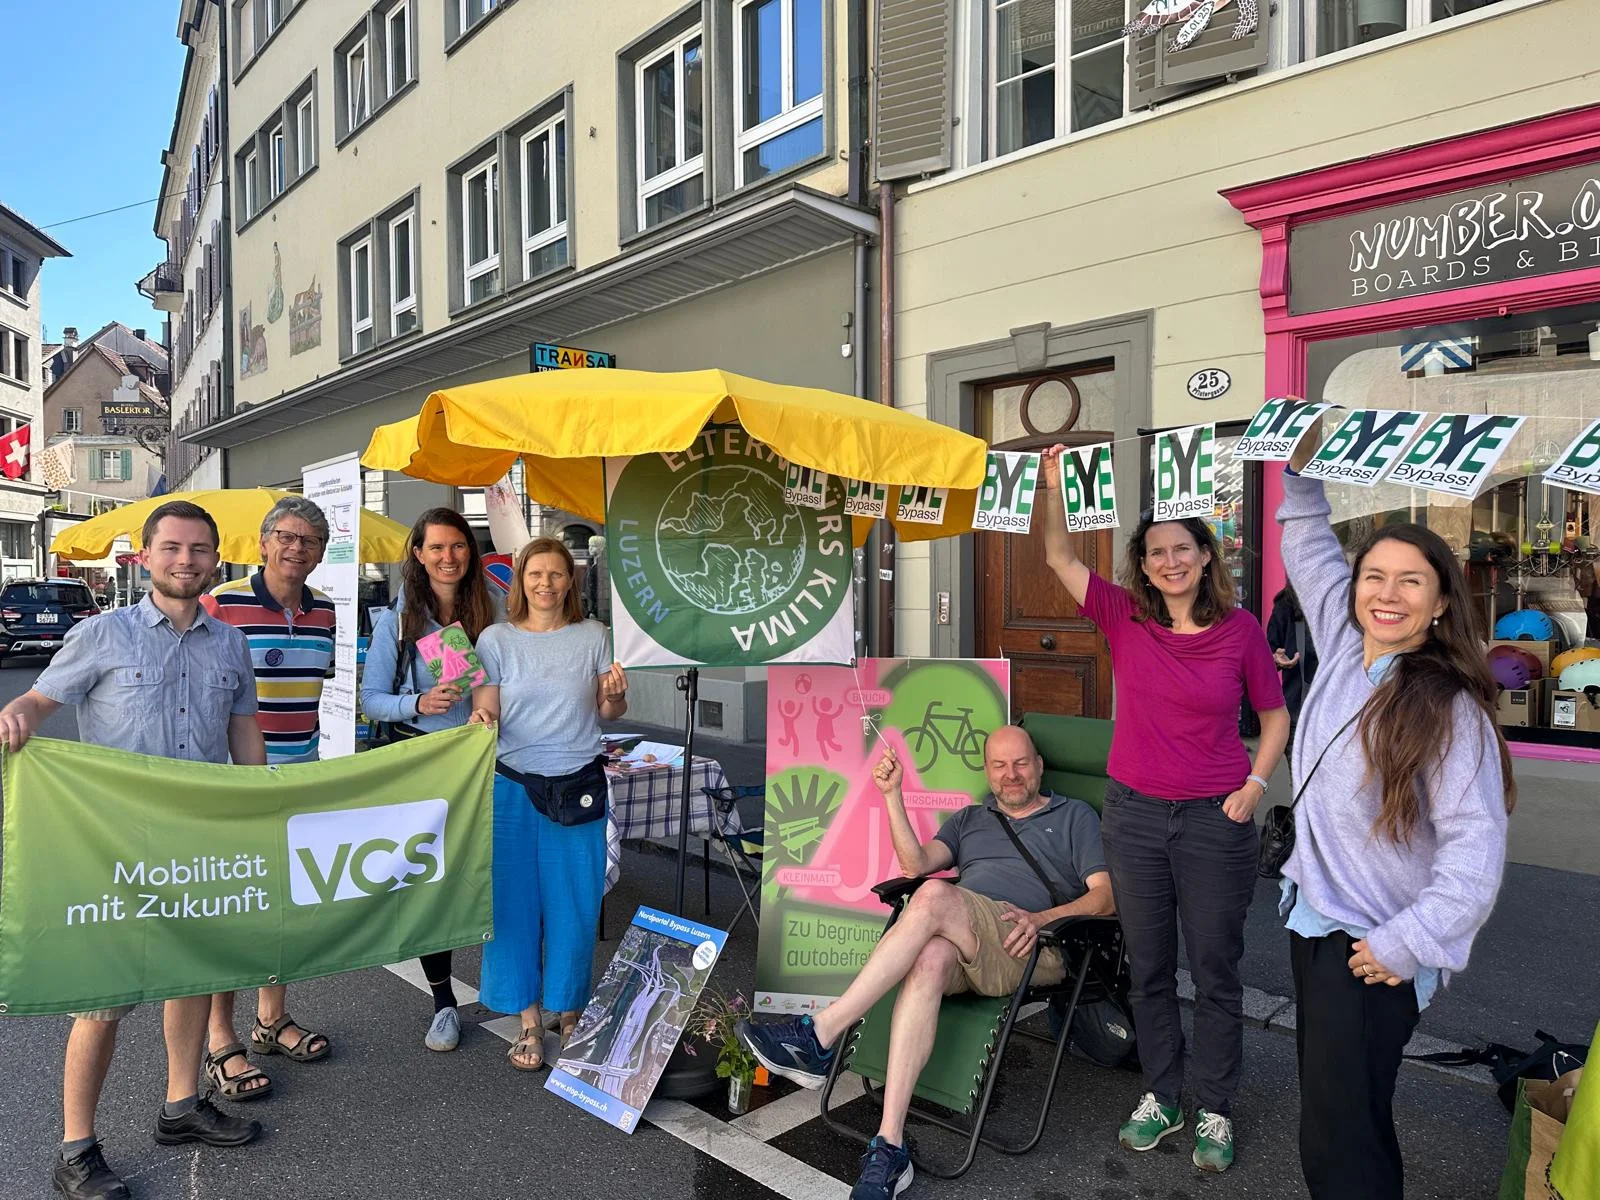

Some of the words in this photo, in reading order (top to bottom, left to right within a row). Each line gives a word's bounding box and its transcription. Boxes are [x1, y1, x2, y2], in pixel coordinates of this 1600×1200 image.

[1350, 255, 1490, 297] BOARDS
[1517, 249, 1535, 269] &
[1198, 371, 1219, 389] 25
[104, 406, 151, 414] BASLERTOR
[1241, 399, 1323, 440] BYE
[1236, 437, 1293, 454] Bypass!
[1315, 411, 1420, 469] BYE
[1398, 415, 1521, 474] BYE
[1158, 427, 1213, 501] BYE
[1306, 459, 1381, 481] Bypass!
[1393, 463, 1477, 487] Bypass!
[977, 453, 1038, 515] BYE
[1062, 447, 1113, 513] BYE
[785, 487, 822, 505] Bypass!
[845, 497, 884, 513] Bypass!
[1157, 495, 1213, 520] Bypass!
[896, 504, 940, 521] Bypass!
[976, 510, 1030, 528] Bypass!
[1068, 510, 1117, 529] Bypass!
[618, 519, 669, 624] LUZERN
[730, 568, 838, 652] KLIMA
[852, 691, 885, 703] BRUCH
[113, 853, 268, 888] Mobilität
[296, 832, 438, 903] VCS
[783, 871, 837, 884] KLEINMATT
[66, 893, 125, 925] mit
[136, 886, 270, 920] Zukunft
[638, 910, 671, 929] Nordportal
[669, 919, 691, 935] Bypass
[690, 927, 711, 940] Luzern
[787, 920, 811, 938] zu
[550, 1077, 608, 1113] www.stop-bypass.ch
